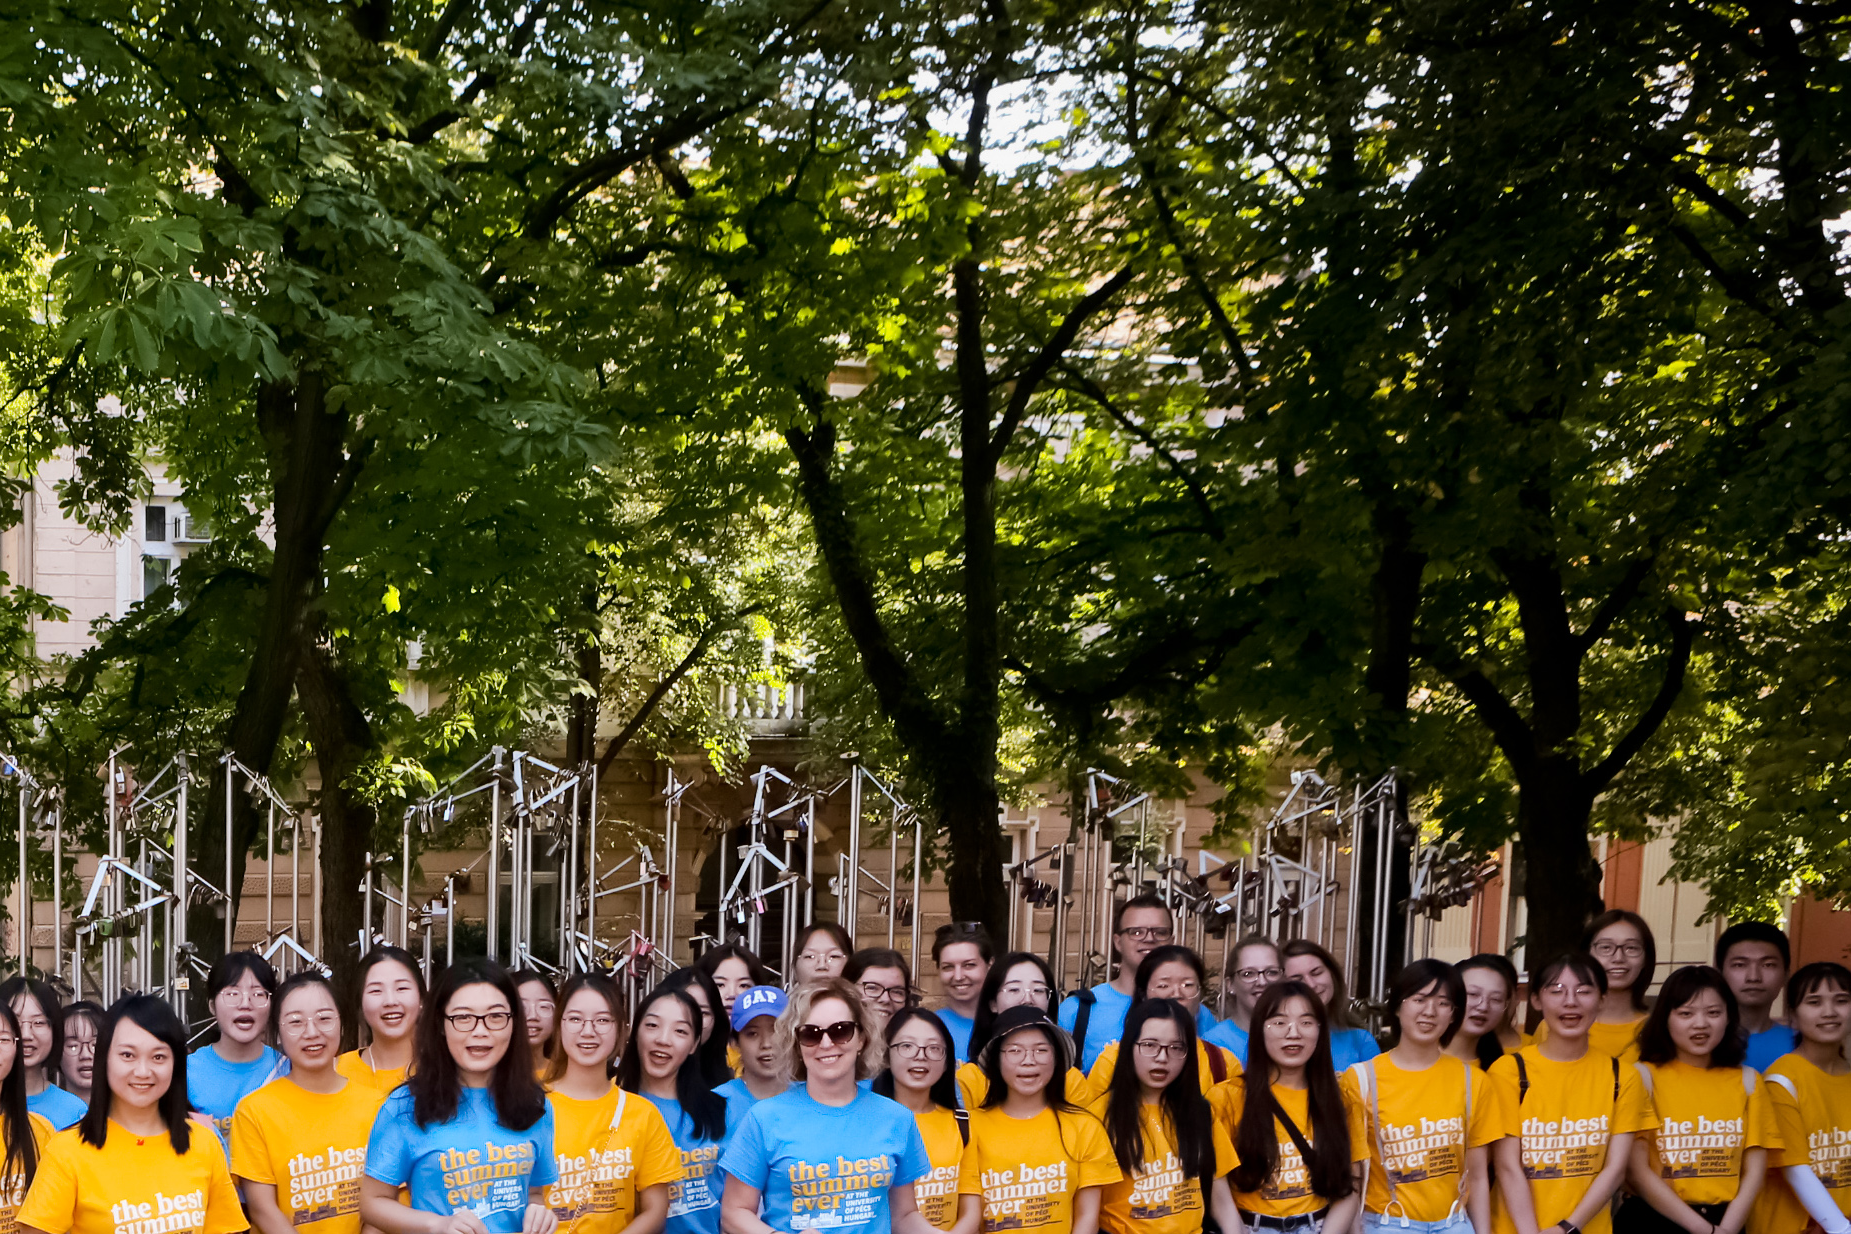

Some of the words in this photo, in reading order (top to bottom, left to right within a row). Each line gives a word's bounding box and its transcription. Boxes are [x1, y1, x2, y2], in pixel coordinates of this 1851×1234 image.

[743, 990, 777, 1010] GAP
[1379, 1123, 1415, 1142] the
[1420, 1115, 1463, 1136] best
[1522, 1117, 1558, 1136] the
[1561, 1114, 1608, 1134] best
[1657, 1117, 1693, 1136] he
[1698, 1115, 1744, 1134] best
[1384, 1132, 1464, 1156] summer
[1521, 1132, 1609, 1150] summer
[1656, 1133, 1744, 1151] summer
[288, 1152, 323, 1177] the
[438, 1147, 481, 1172] the
[485, 1141, 533, 1162] best
[554, 1153, 586, 1174] he
[1385, 1150, 1428, 1171] ever
[1522, 1149, 1566, 1164] ever
[1659, 1149, 1701, 1164] ever
[290, 1163, 365, 1194] summe
[788, 1160, 830, 1183] the
[836, 1154, 890, 1177] best
[981, 1168, 1013, 1189] the
[1019, 1160, 1067, 1182] best
[447, 1181, 494, 1206] ever
[791, 1172, 893, 1197] summer
[983, 1178, 1067, 1203] summer
[290, 1184, 337, 1209] ever
[792, 1192, 845, 1213] ever
[845, 1195, 881, 1207] UNIVERSITY
[1129, 1186, 1172, 1205] ever
[111, 1199, 152, 1224] the
[155, 1189, 203, 1216] best
[854, 1204, 871, 1212] PÉCS
[983, 1199, 1025, 1217] ever
